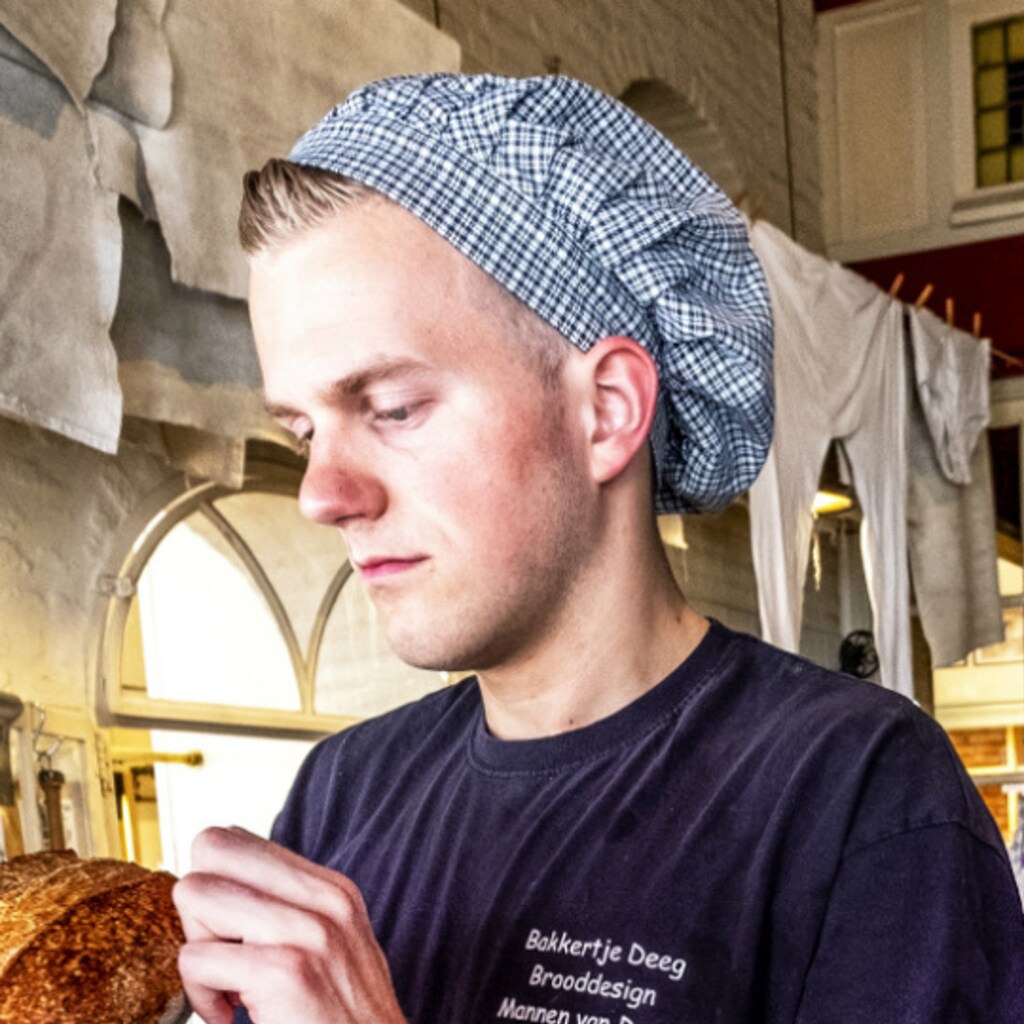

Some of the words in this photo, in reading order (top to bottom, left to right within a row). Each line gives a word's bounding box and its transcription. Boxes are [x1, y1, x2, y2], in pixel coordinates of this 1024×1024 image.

[525, 928, 622, 966] Bakkertje
[627, 942, 687, 981] Deeg
[528, 964, 657, 1009] Brooddesign
